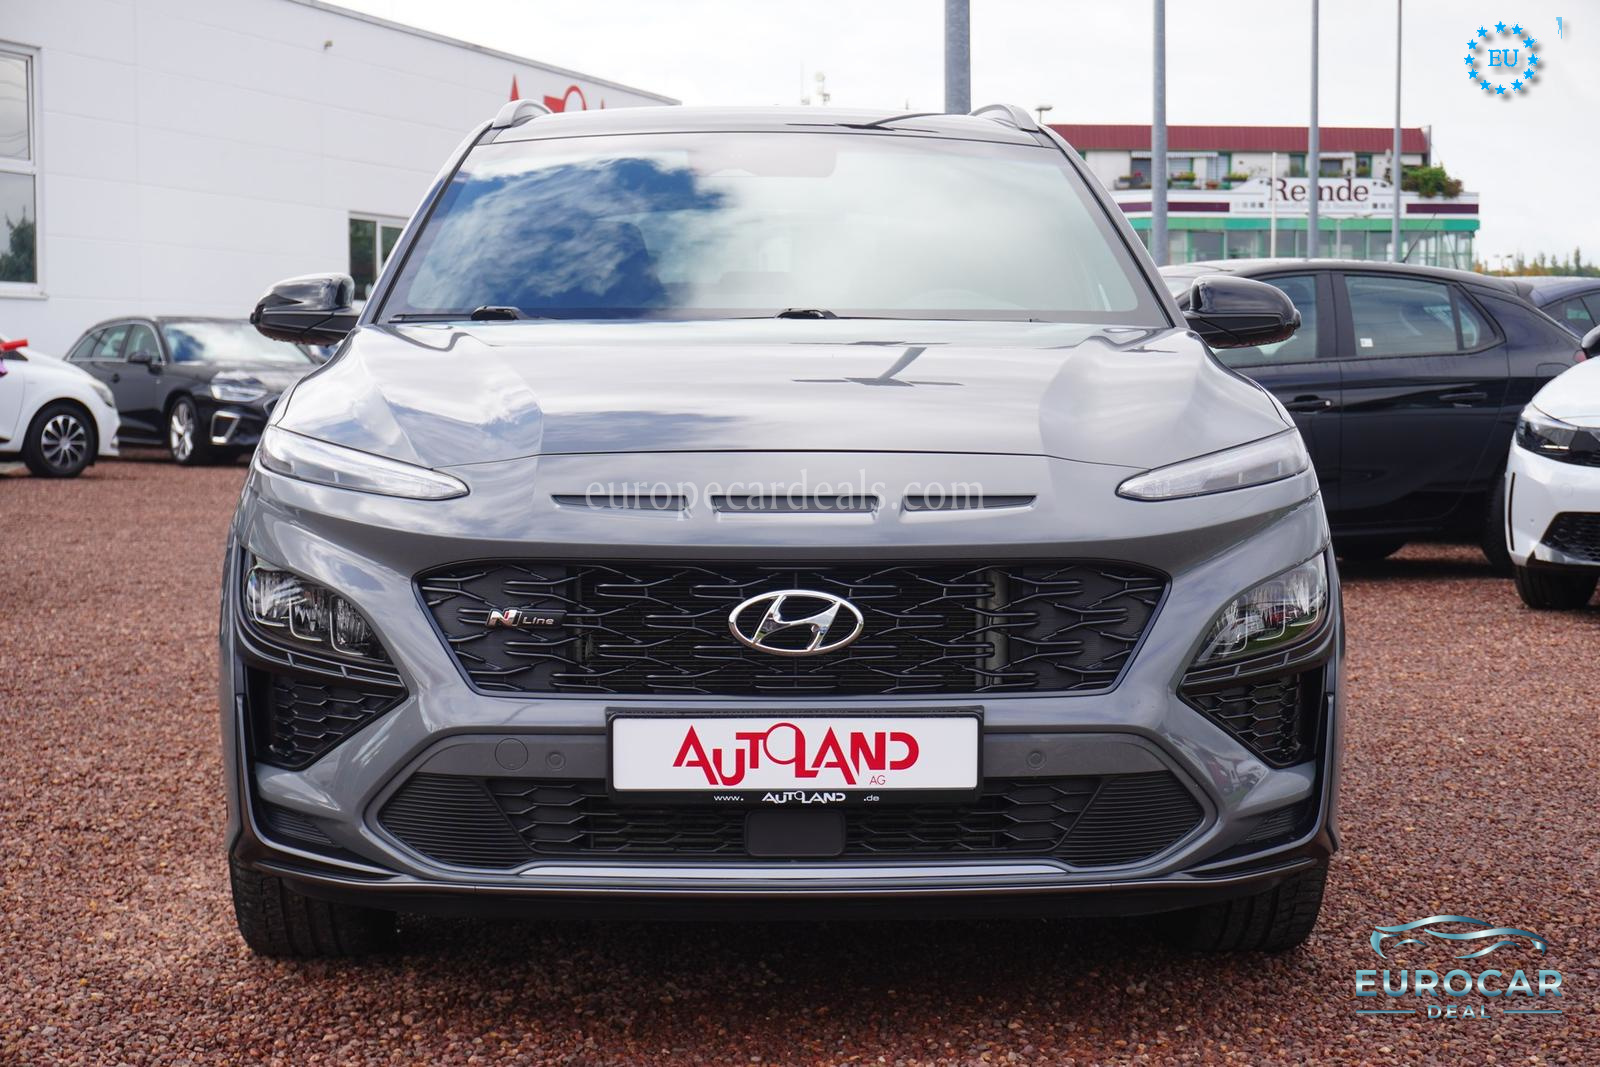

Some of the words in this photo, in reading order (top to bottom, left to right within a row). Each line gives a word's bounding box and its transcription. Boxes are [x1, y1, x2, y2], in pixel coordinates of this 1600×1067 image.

[487, 607, 522, 629] N
[522, 616, 555, 625] Line
[869, 774, 887, 786] AG
